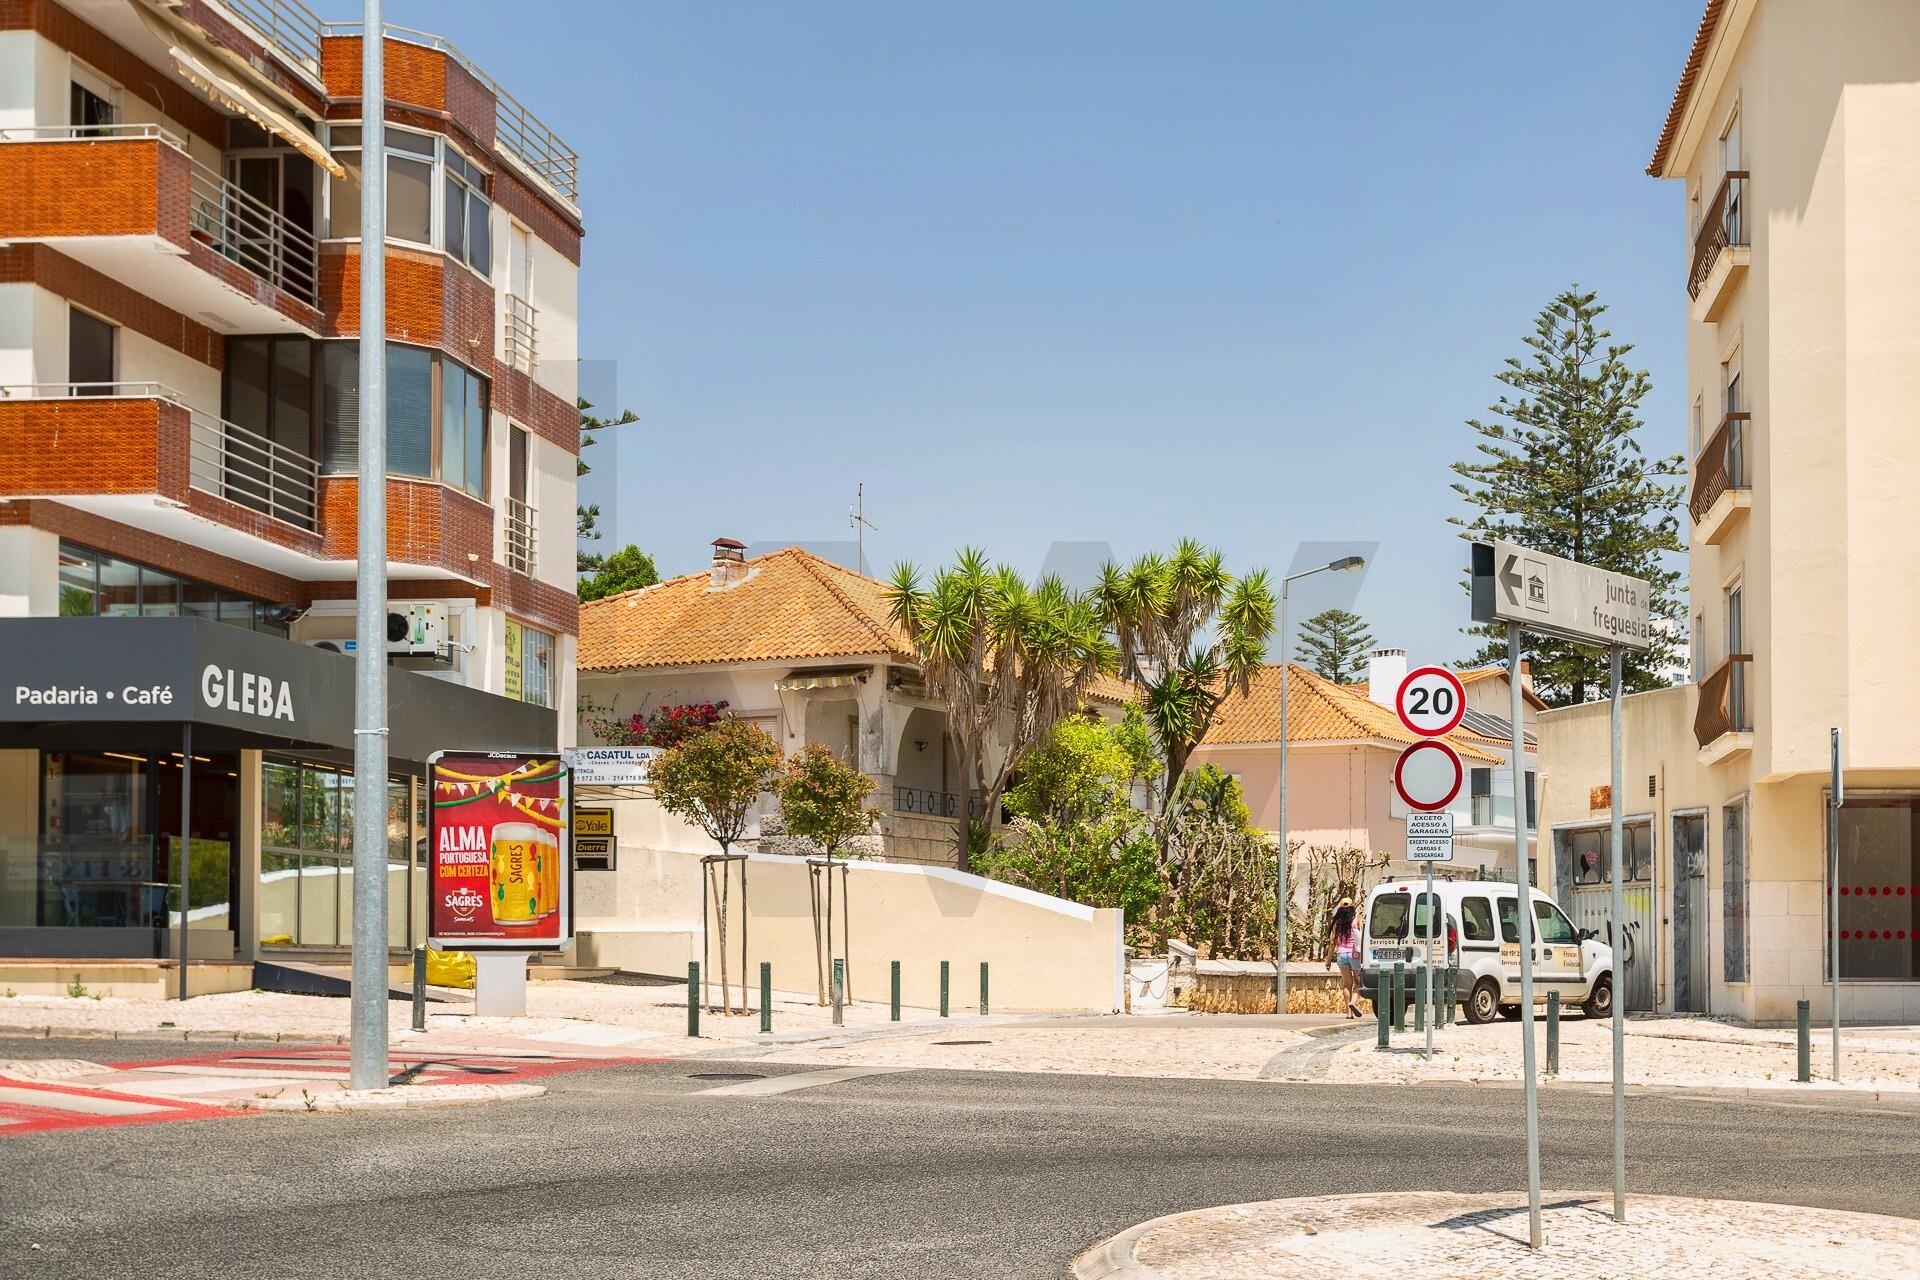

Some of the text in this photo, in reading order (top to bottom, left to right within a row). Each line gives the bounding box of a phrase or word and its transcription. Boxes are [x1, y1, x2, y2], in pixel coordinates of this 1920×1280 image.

[1606, 579, 1637, 606] junta
[1592, 606, 1648, 639] freguesia
[15, 685, 173, 705] Padaria Café
[201, 663, 296, 722] GLEBA
[1408, 687, 1453, 715] 20
[587, 751, 634, 760] CASATUL
[586, 820, 608, 832] Yale
[440, 826, 487, 851] ALMA
[440, 852, 490, 865] PORTUGUESA,
[509, 845, 524, 884] SAGRES
[440, 864, 489, 878] COM CERTEZA
[445, 895, 483, 907] SAGRES
